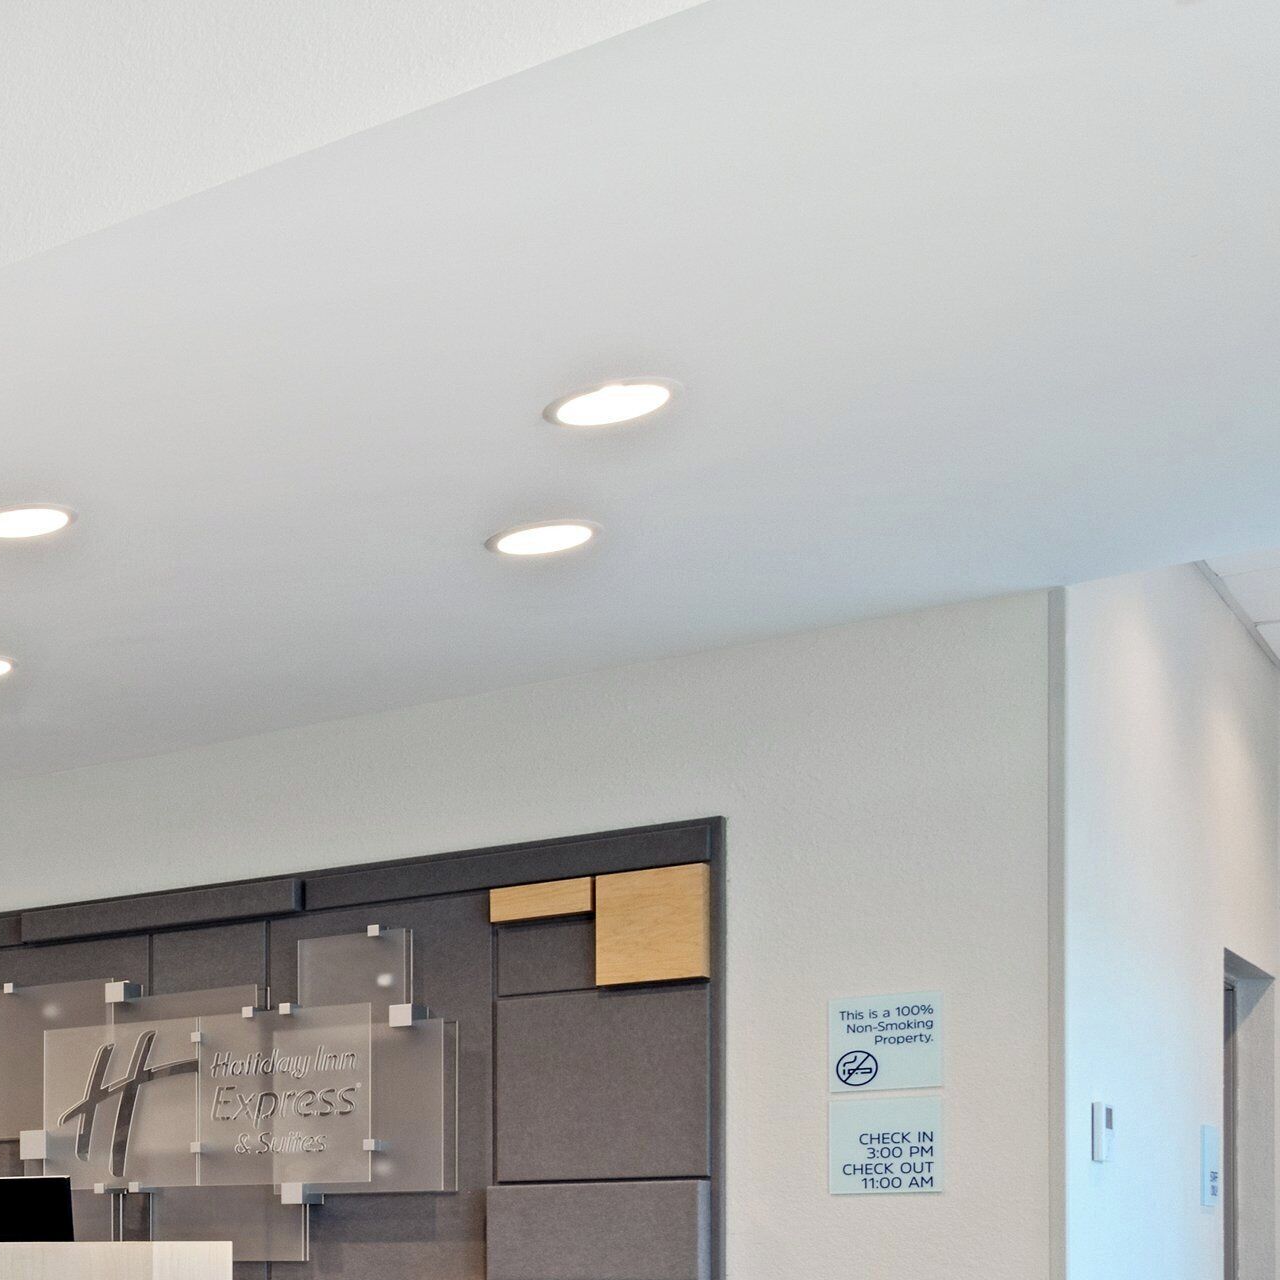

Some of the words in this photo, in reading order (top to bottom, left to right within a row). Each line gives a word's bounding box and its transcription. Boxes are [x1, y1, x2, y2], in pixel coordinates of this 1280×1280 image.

[839, 1010, 864, 1020] This
[868, 1008, 878, 1019] is
[882, 1009, 890, 1018] a
[896, 1004, 934, 1016] 100%
[846, 1019, 934, 1034] Non-Smoking
[874, 1033, 934, 1045] Property.
[210, 1047, 311, 1080] Holiday
[314, 1045, 356, 1072] Inn
[210, 1085, 356, 1130] Express
[234, 1132, 252, 1154] &
[256, 1131, 328, 1155] Suites
[859, 1132, 912, 1145] CHECK
[918, 1131, 934, 1142] IN
[866, 1146, 902, 1159] 3:00
[909, 1146, 934, 1158] PM
[842, 1163, 894, 1176] CHECK
[900, 1162, 934, 1174] OUT
[861, 1177, 902, 1189] 11:00
[908, 1176, 934, 1188] AM
